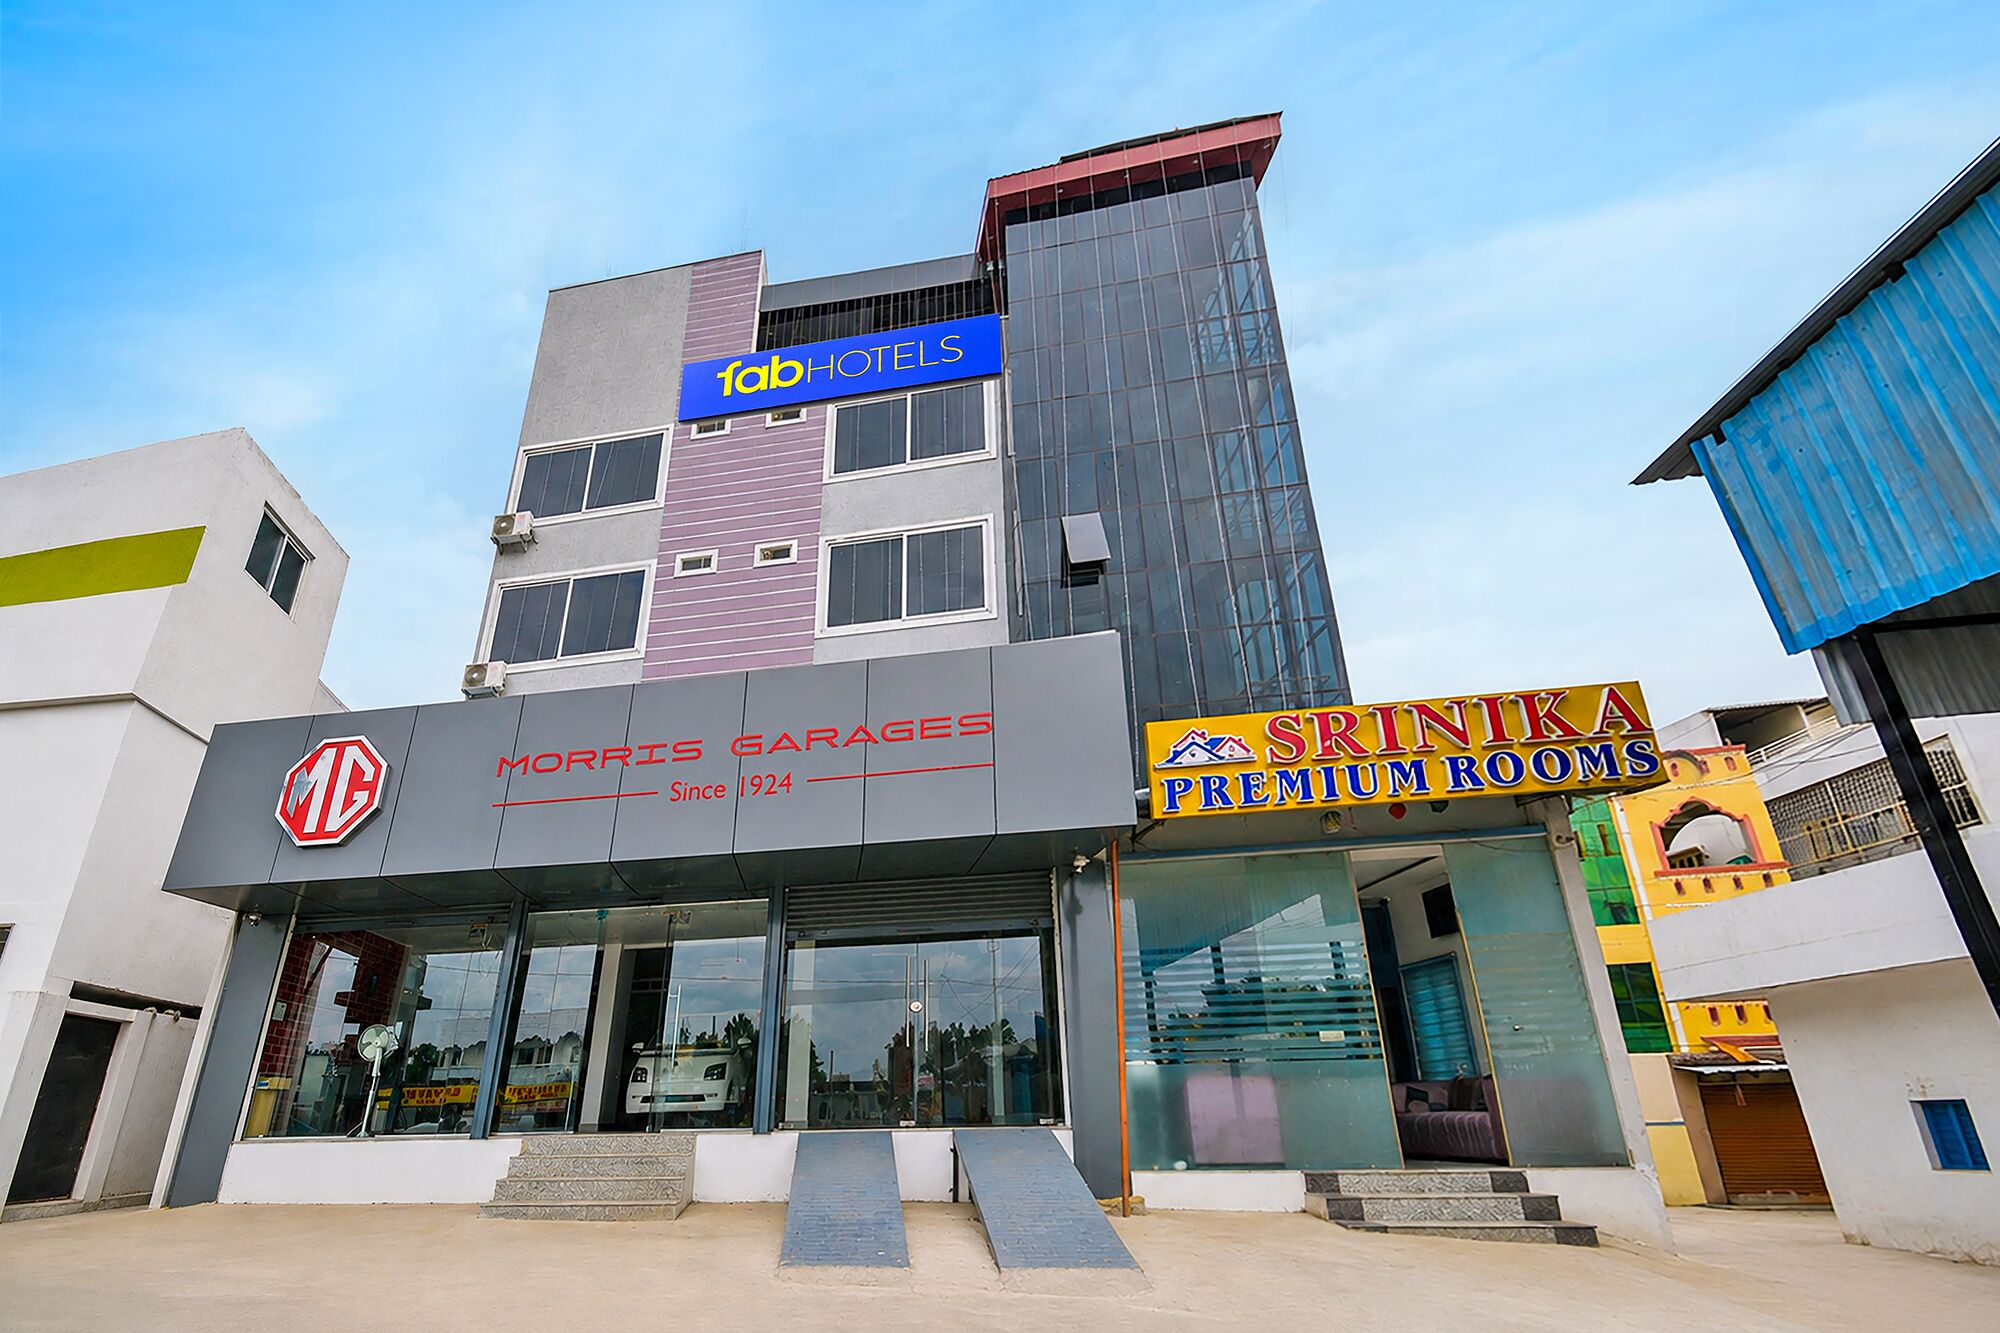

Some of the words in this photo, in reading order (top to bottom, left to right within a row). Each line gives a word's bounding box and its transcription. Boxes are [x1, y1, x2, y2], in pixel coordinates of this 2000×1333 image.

[717, 335, 963, 397] fabHOTELS
[497, 738, 703, 778] MORRIS
[731, 711, 993, 757] GARAGES
[1265, 686, 1655, 764] SRINIKA
[284, 745, 376, 834] MG
[669, 780, 727, 803] Since
[740, 772, 793, 799] 1924
[1162, 757, 1431, 814] PREMIUM
[1442, 740, 1660, 793] ROOMS
